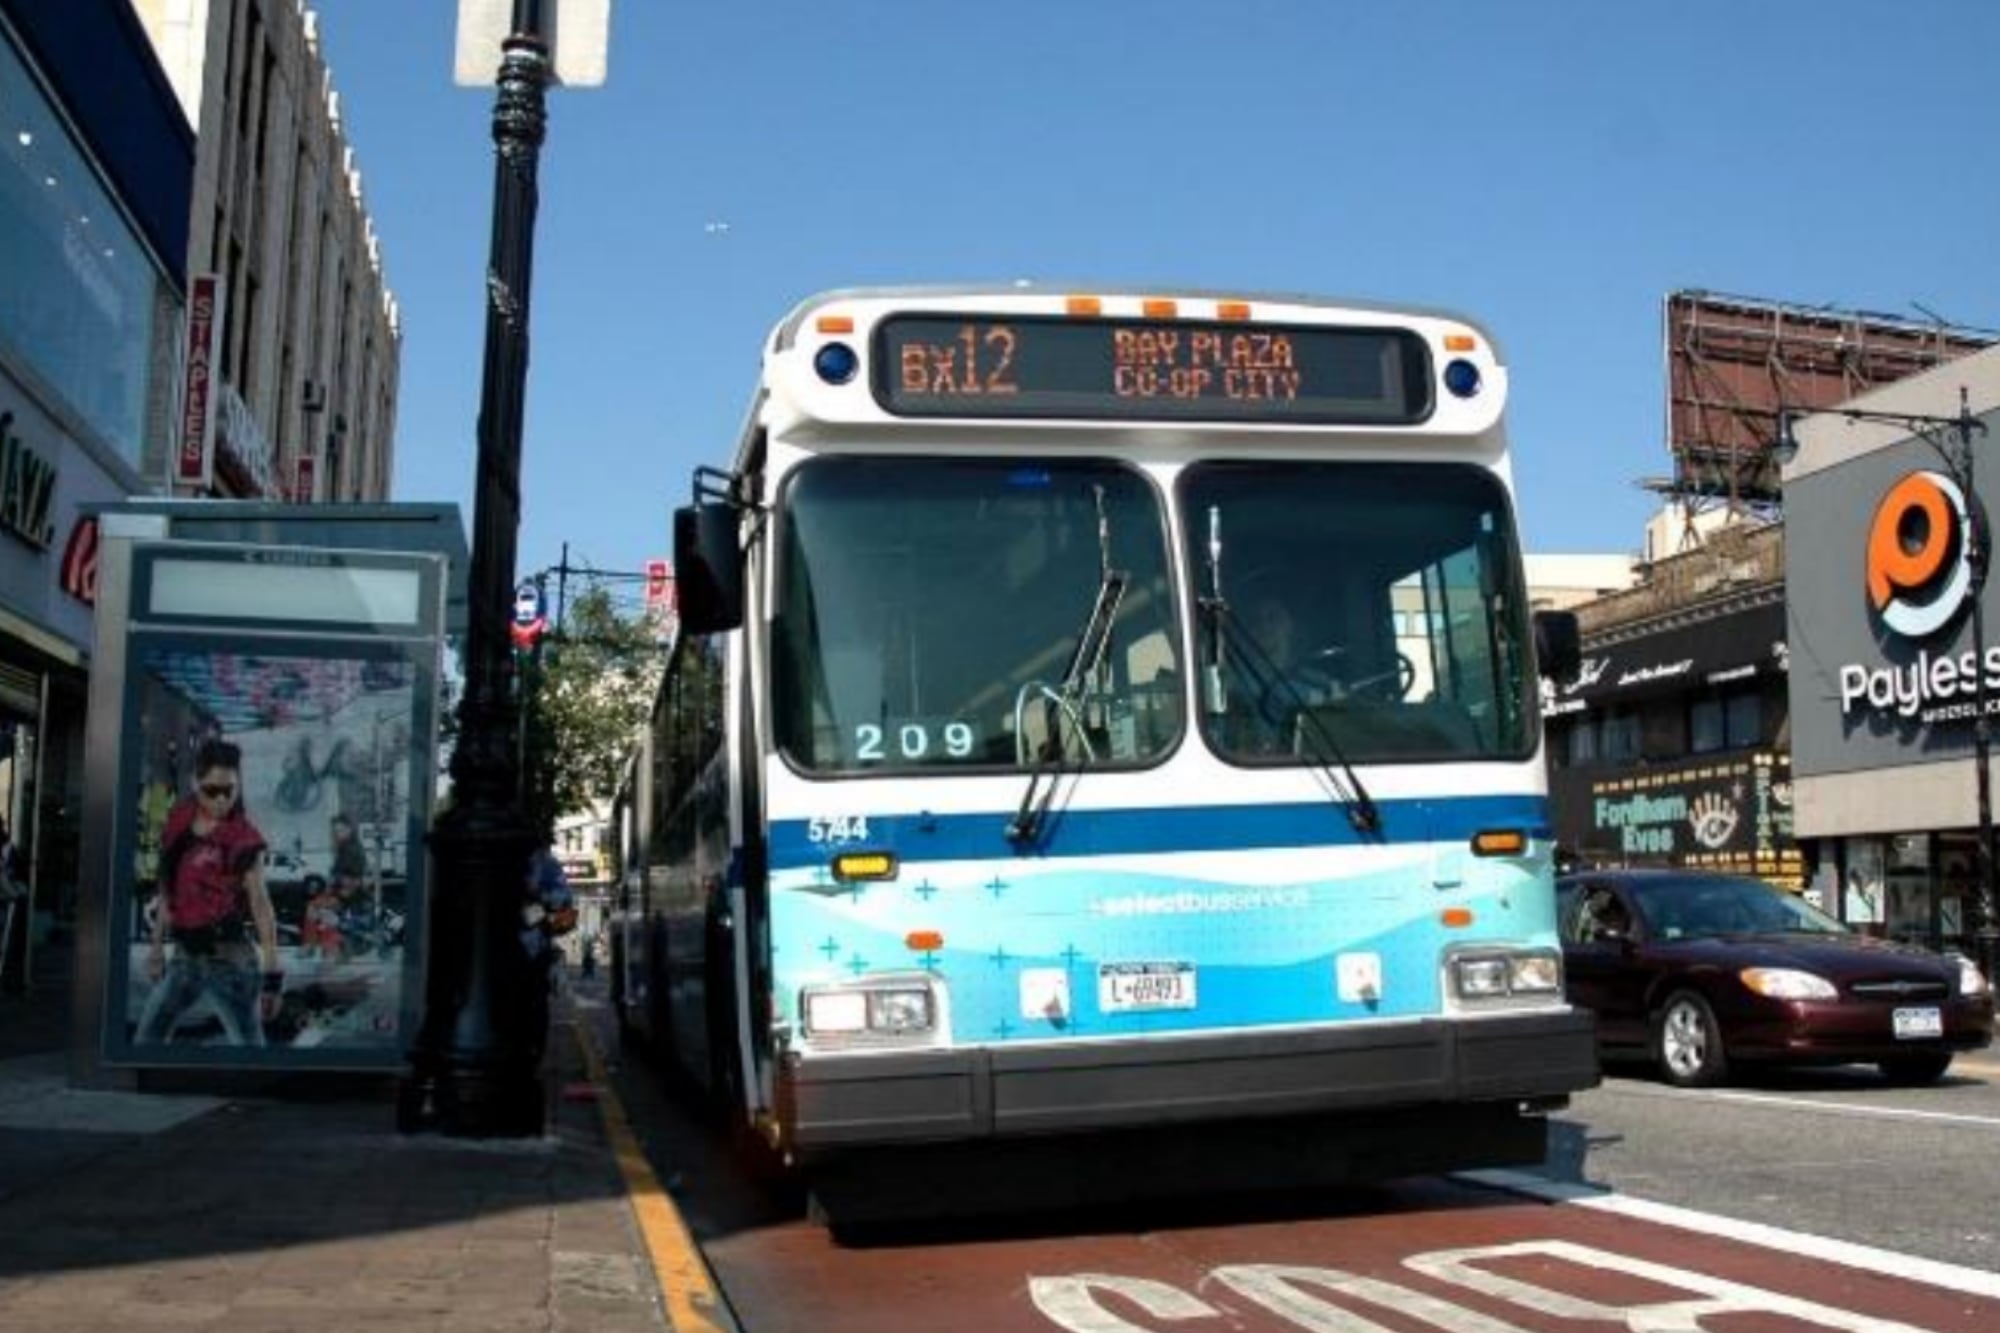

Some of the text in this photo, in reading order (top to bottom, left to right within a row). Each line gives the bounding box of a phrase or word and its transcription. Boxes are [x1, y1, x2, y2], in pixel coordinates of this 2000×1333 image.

[1113, 329, 1293, 368] BAY PLAZA
[1113, 365, 1300, 400] CO-OP CITY
[1840, 647, 2000, 717] Payless
